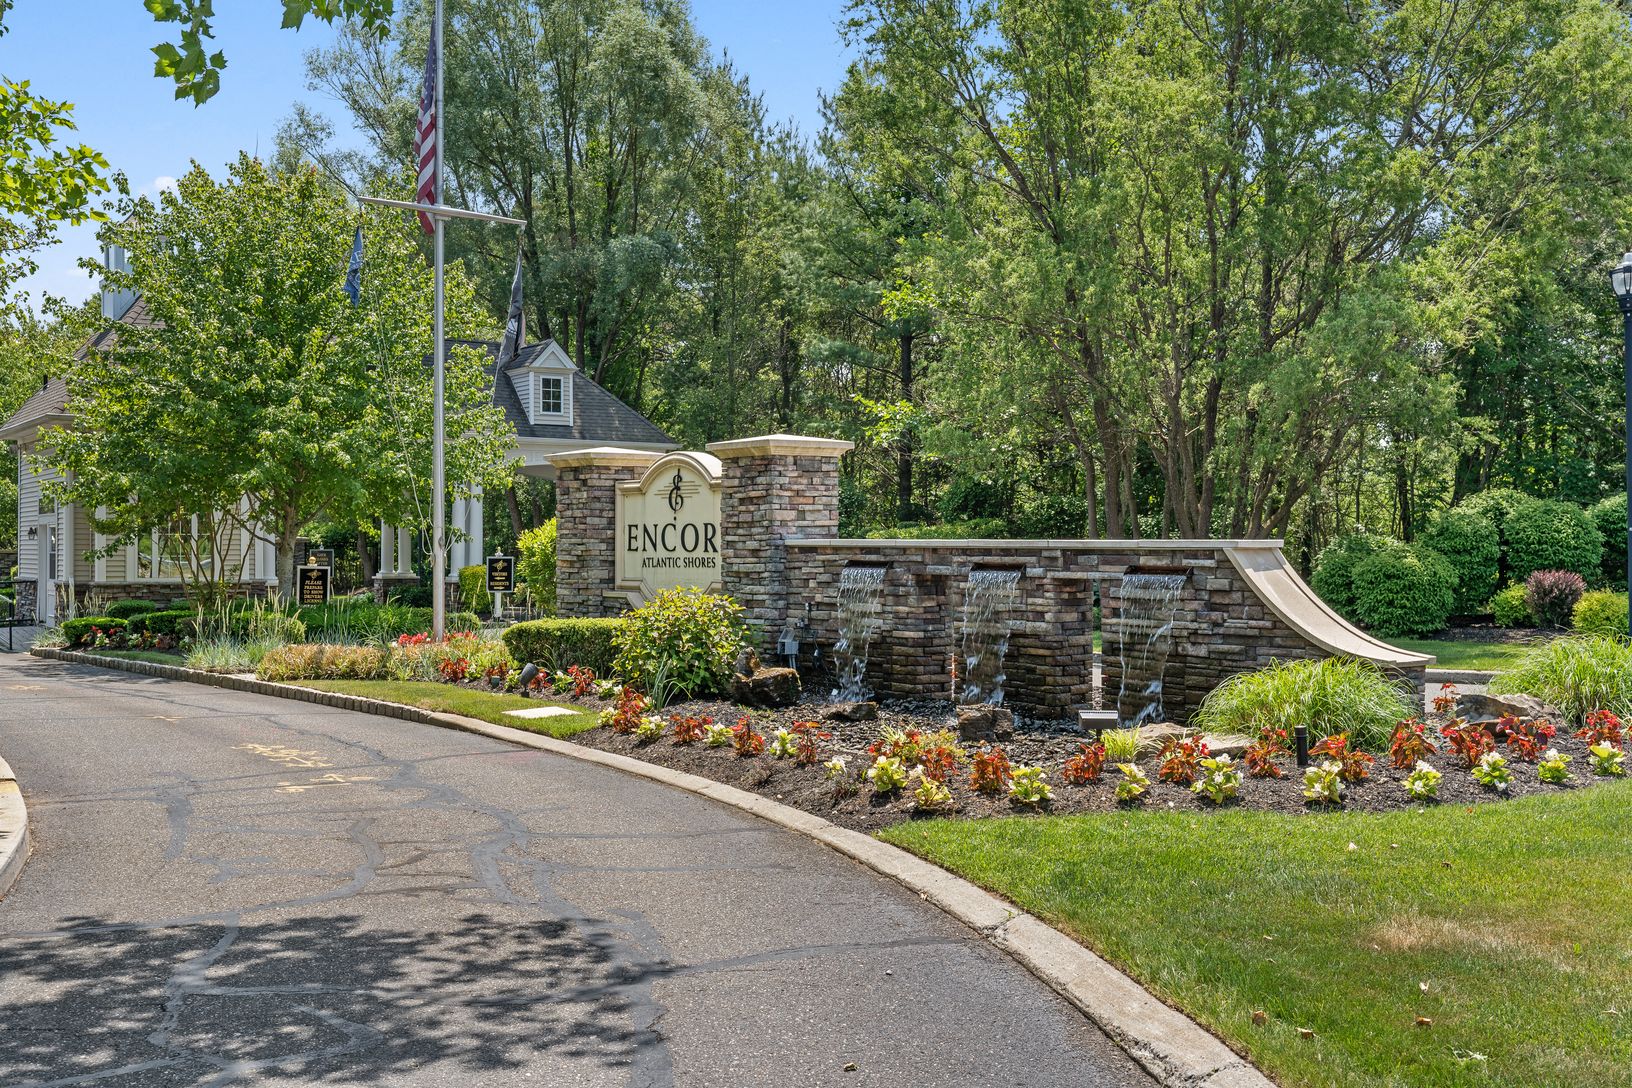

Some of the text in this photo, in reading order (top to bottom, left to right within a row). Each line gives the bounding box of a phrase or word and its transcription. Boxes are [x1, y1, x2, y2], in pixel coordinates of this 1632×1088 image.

[627, 523, 718, 552] ENCOR
[642, 557, 716, 568] ATLANTIC SHORES
